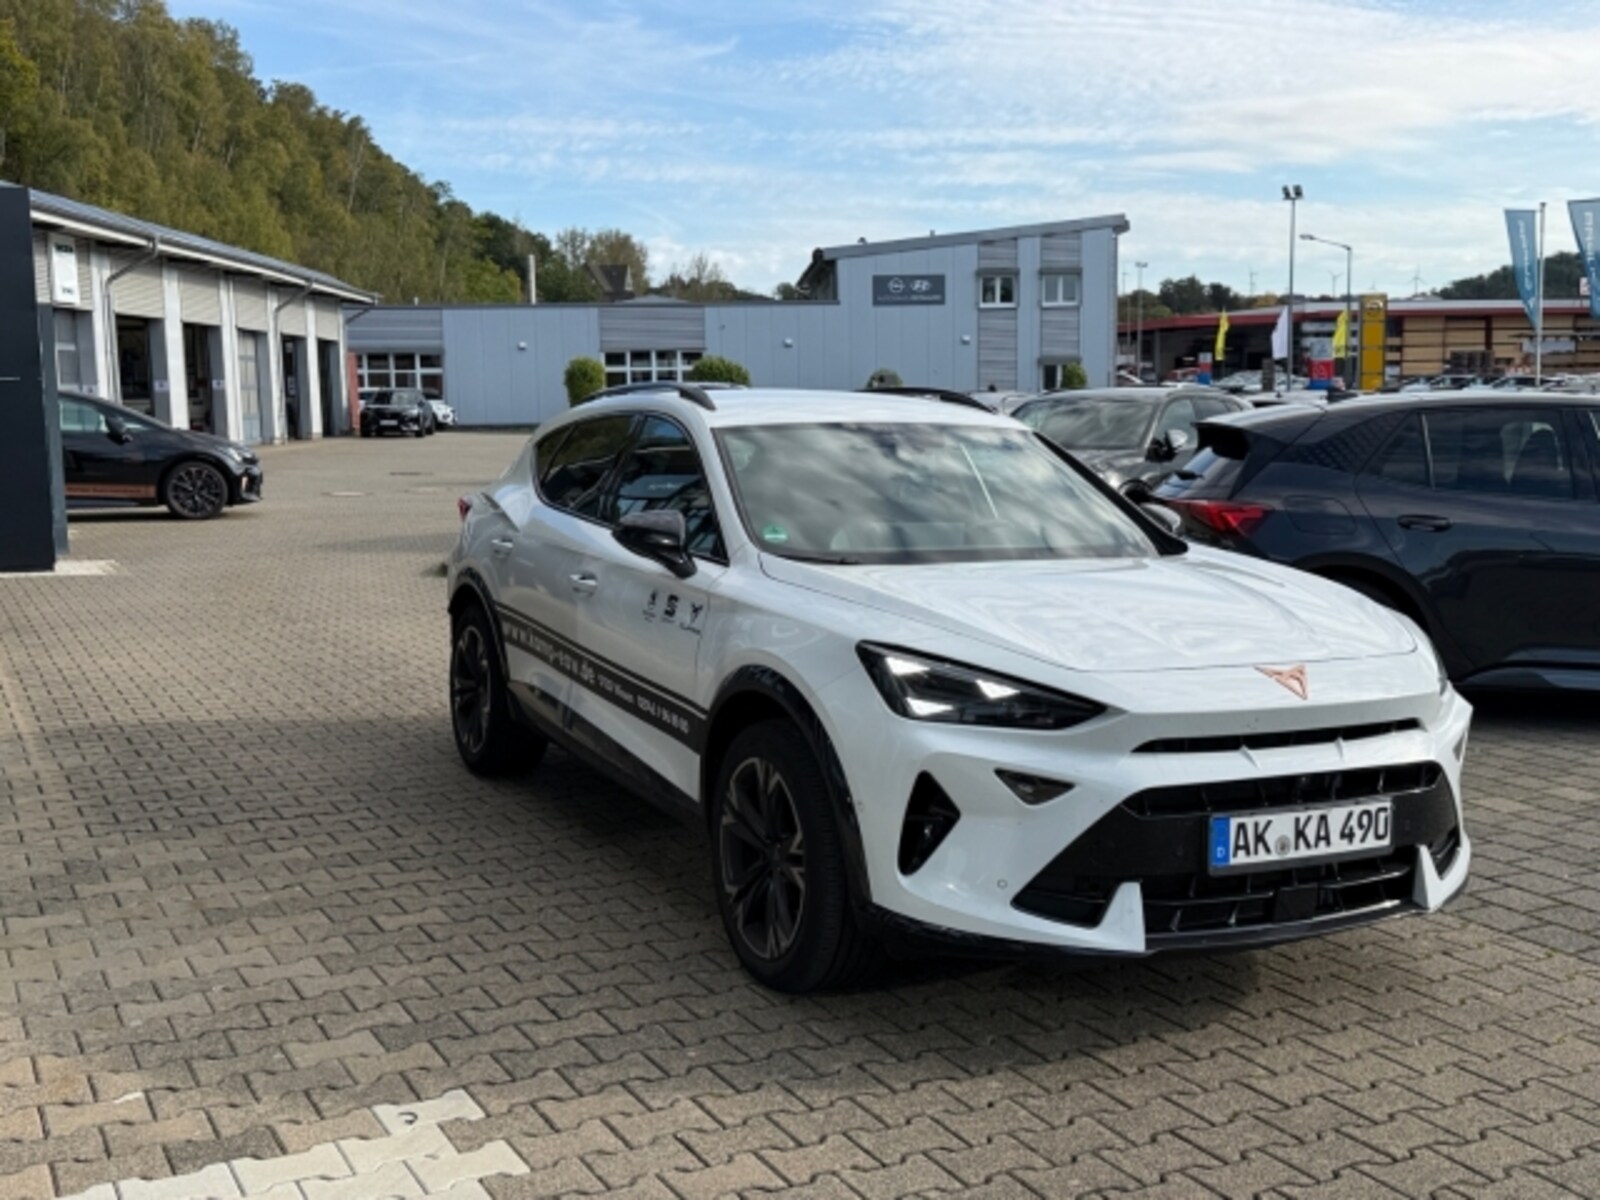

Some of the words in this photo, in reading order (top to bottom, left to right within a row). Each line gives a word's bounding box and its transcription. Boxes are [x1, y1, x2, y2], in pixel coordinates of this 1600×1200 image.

[1232, 819, 1273, 858] AK
[1294, 814, 1331, 851] KA
[1339, 806, 1389, 845] 490
[1216, 846, 1226, 858] D
